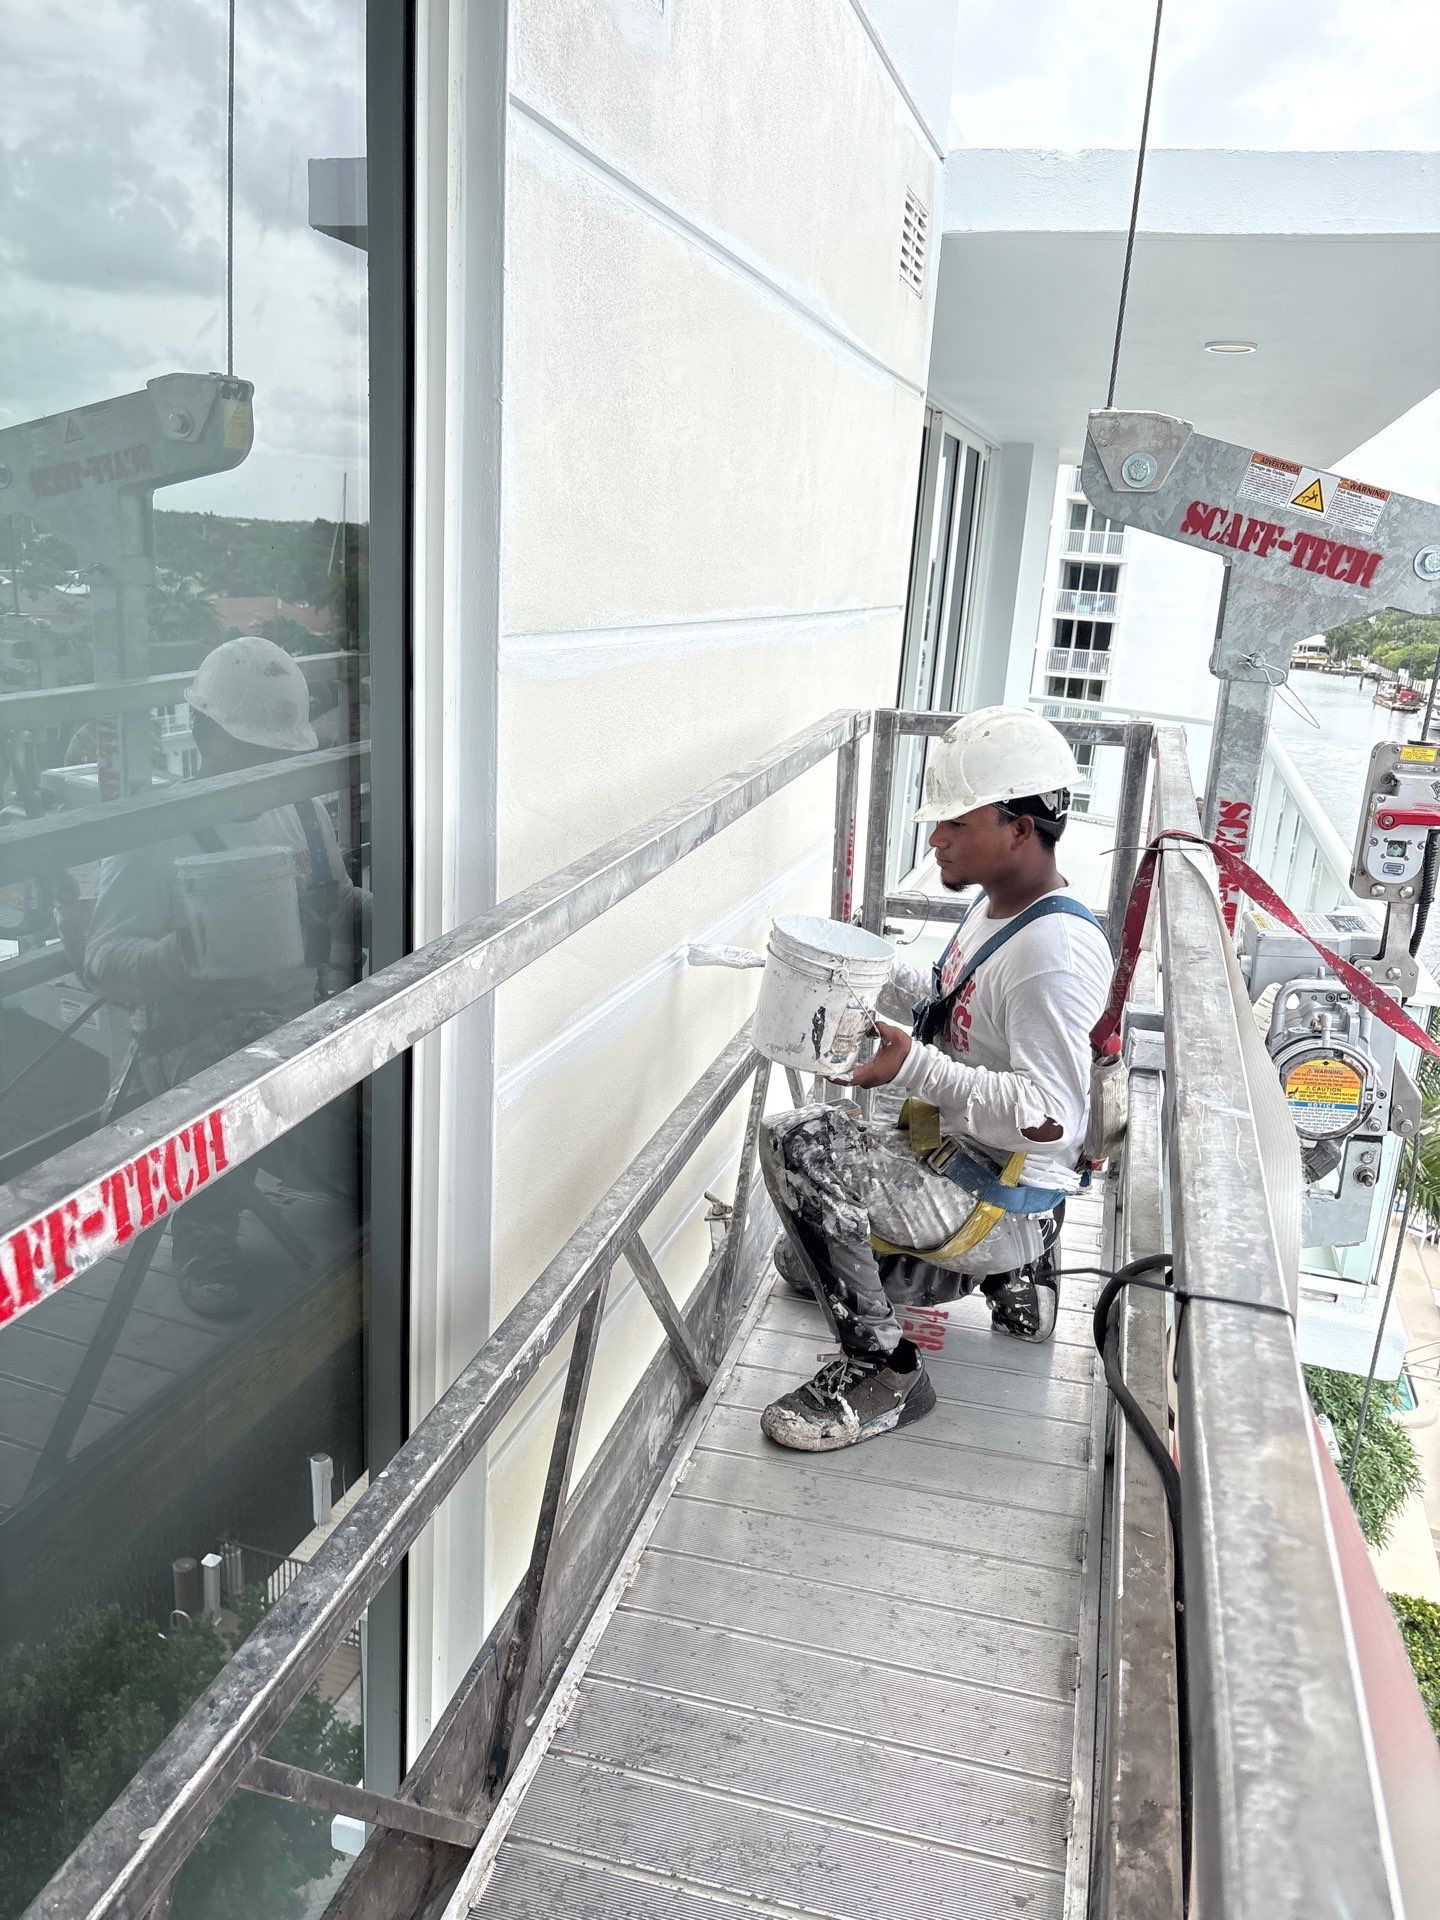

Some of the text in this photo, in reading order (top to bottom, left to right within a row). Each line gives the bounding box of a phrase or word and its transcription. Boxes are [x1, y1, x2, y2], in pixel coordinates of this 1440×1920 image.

[1260, 457, 1300, 474] ADVERTENCIA
[1349, 482, 1386, 499] WARNING
[1181, 500, 1384, 589] SCAFF-TECH
